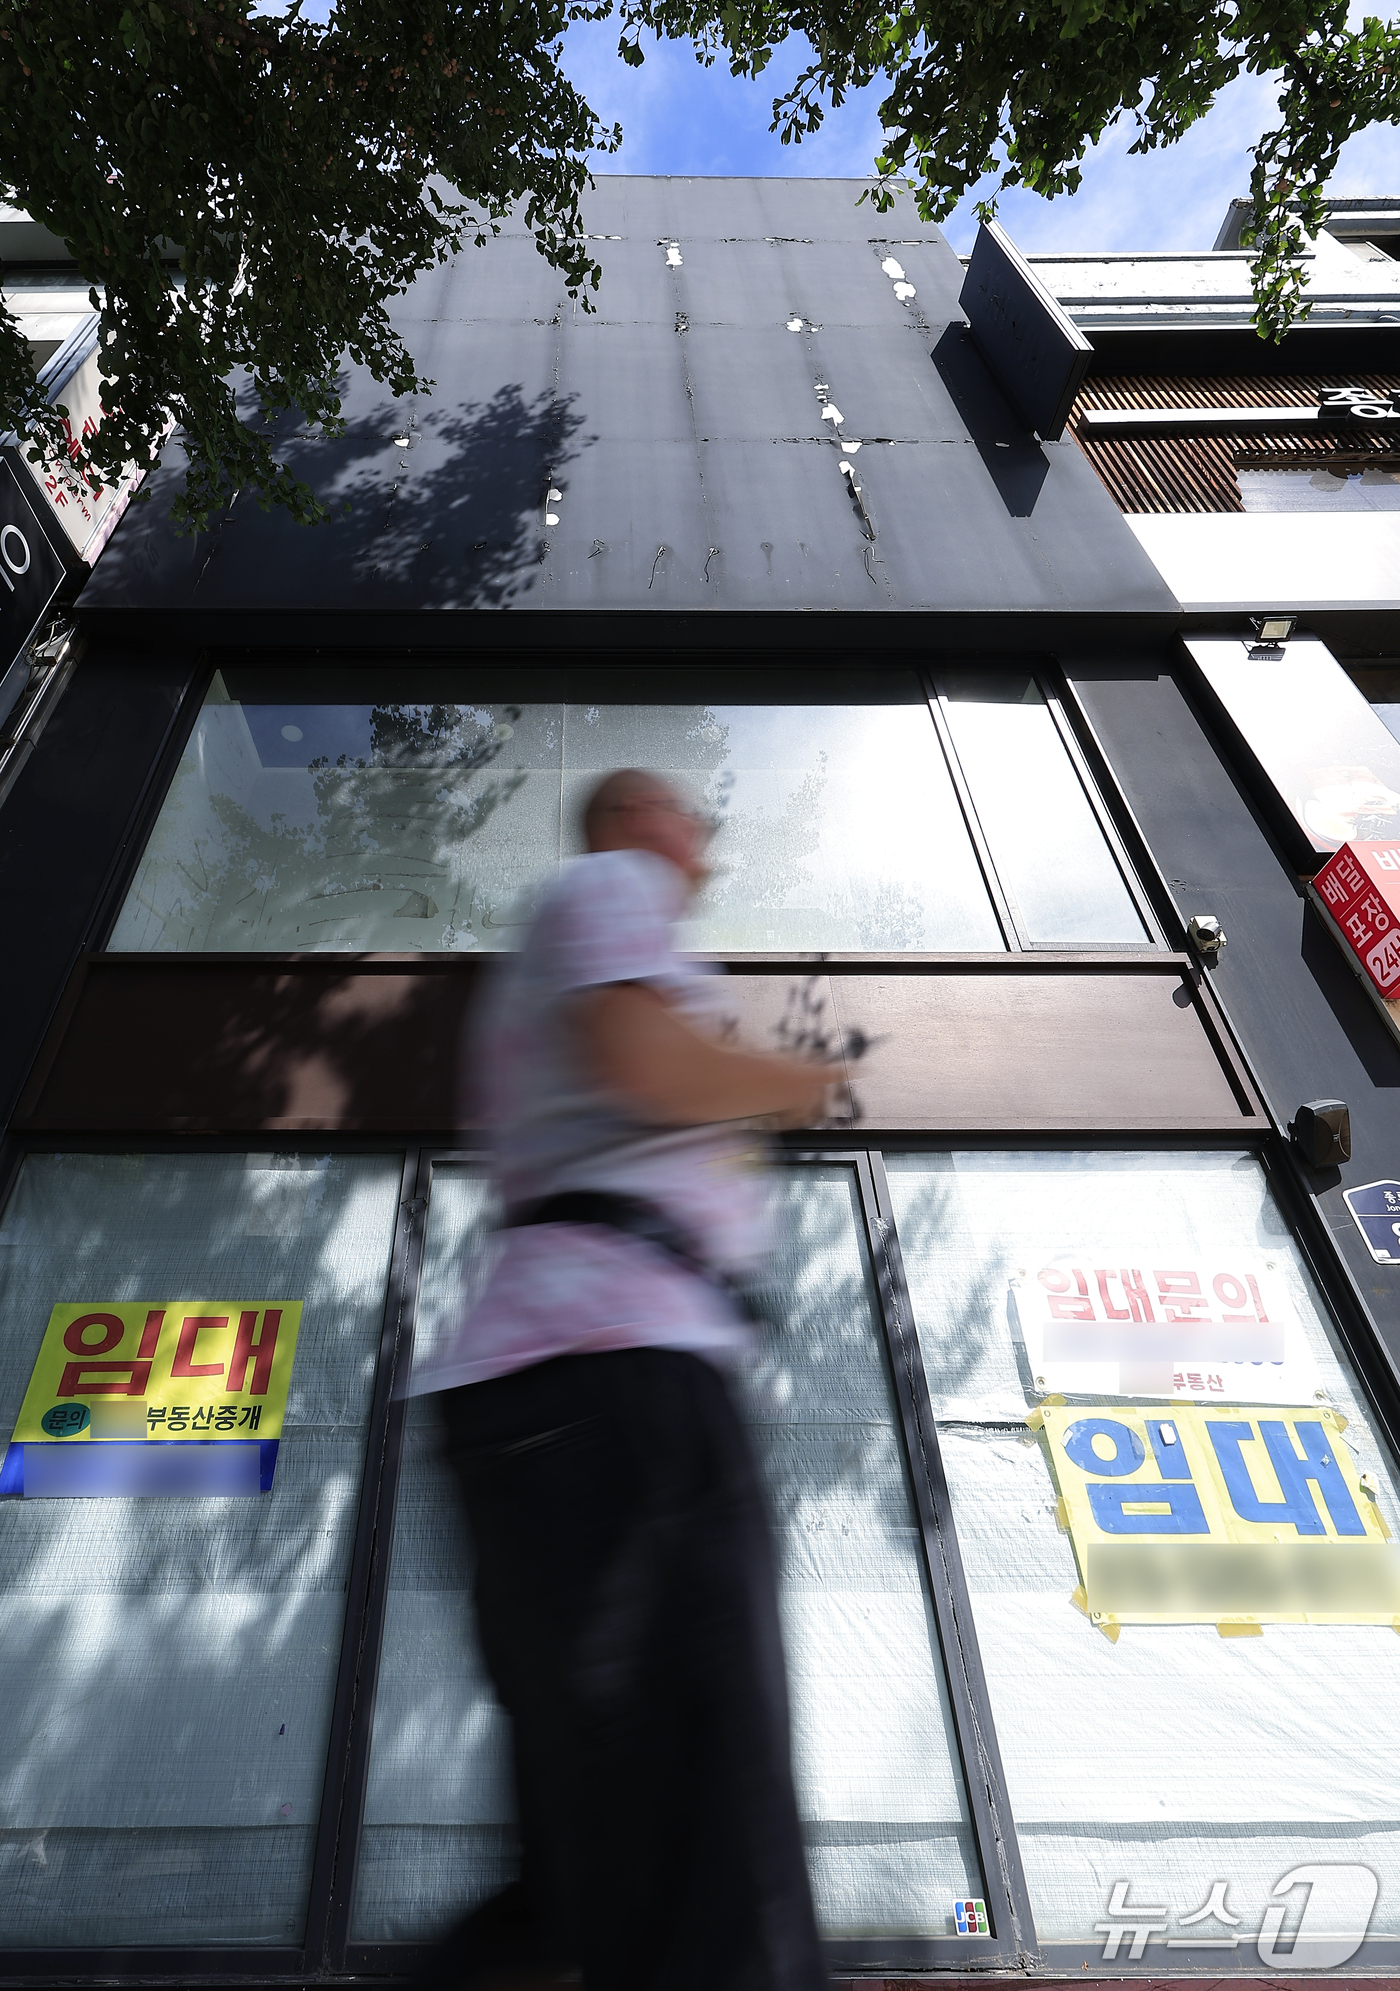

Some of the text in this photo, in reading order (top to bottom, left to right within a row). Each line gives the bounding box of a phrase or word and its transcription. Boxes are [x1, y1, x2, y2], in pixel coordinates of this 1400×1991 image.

[44, 475, 69, 507] 2F
[1321, 854, 1365, 905] 배달
[1345, 892, 1390, 949] 포장
[1037, 1268, 1270, 1323] 임대문의
[56, 1309, 283, 1397] 임대
[49, 1409, 86, 1430] 문의
[147, 1405, 262, 1431] 부동산중개
[1062, 1417, 1368, 1537] 임대
[956, 1911, 986, 1924] JCB
